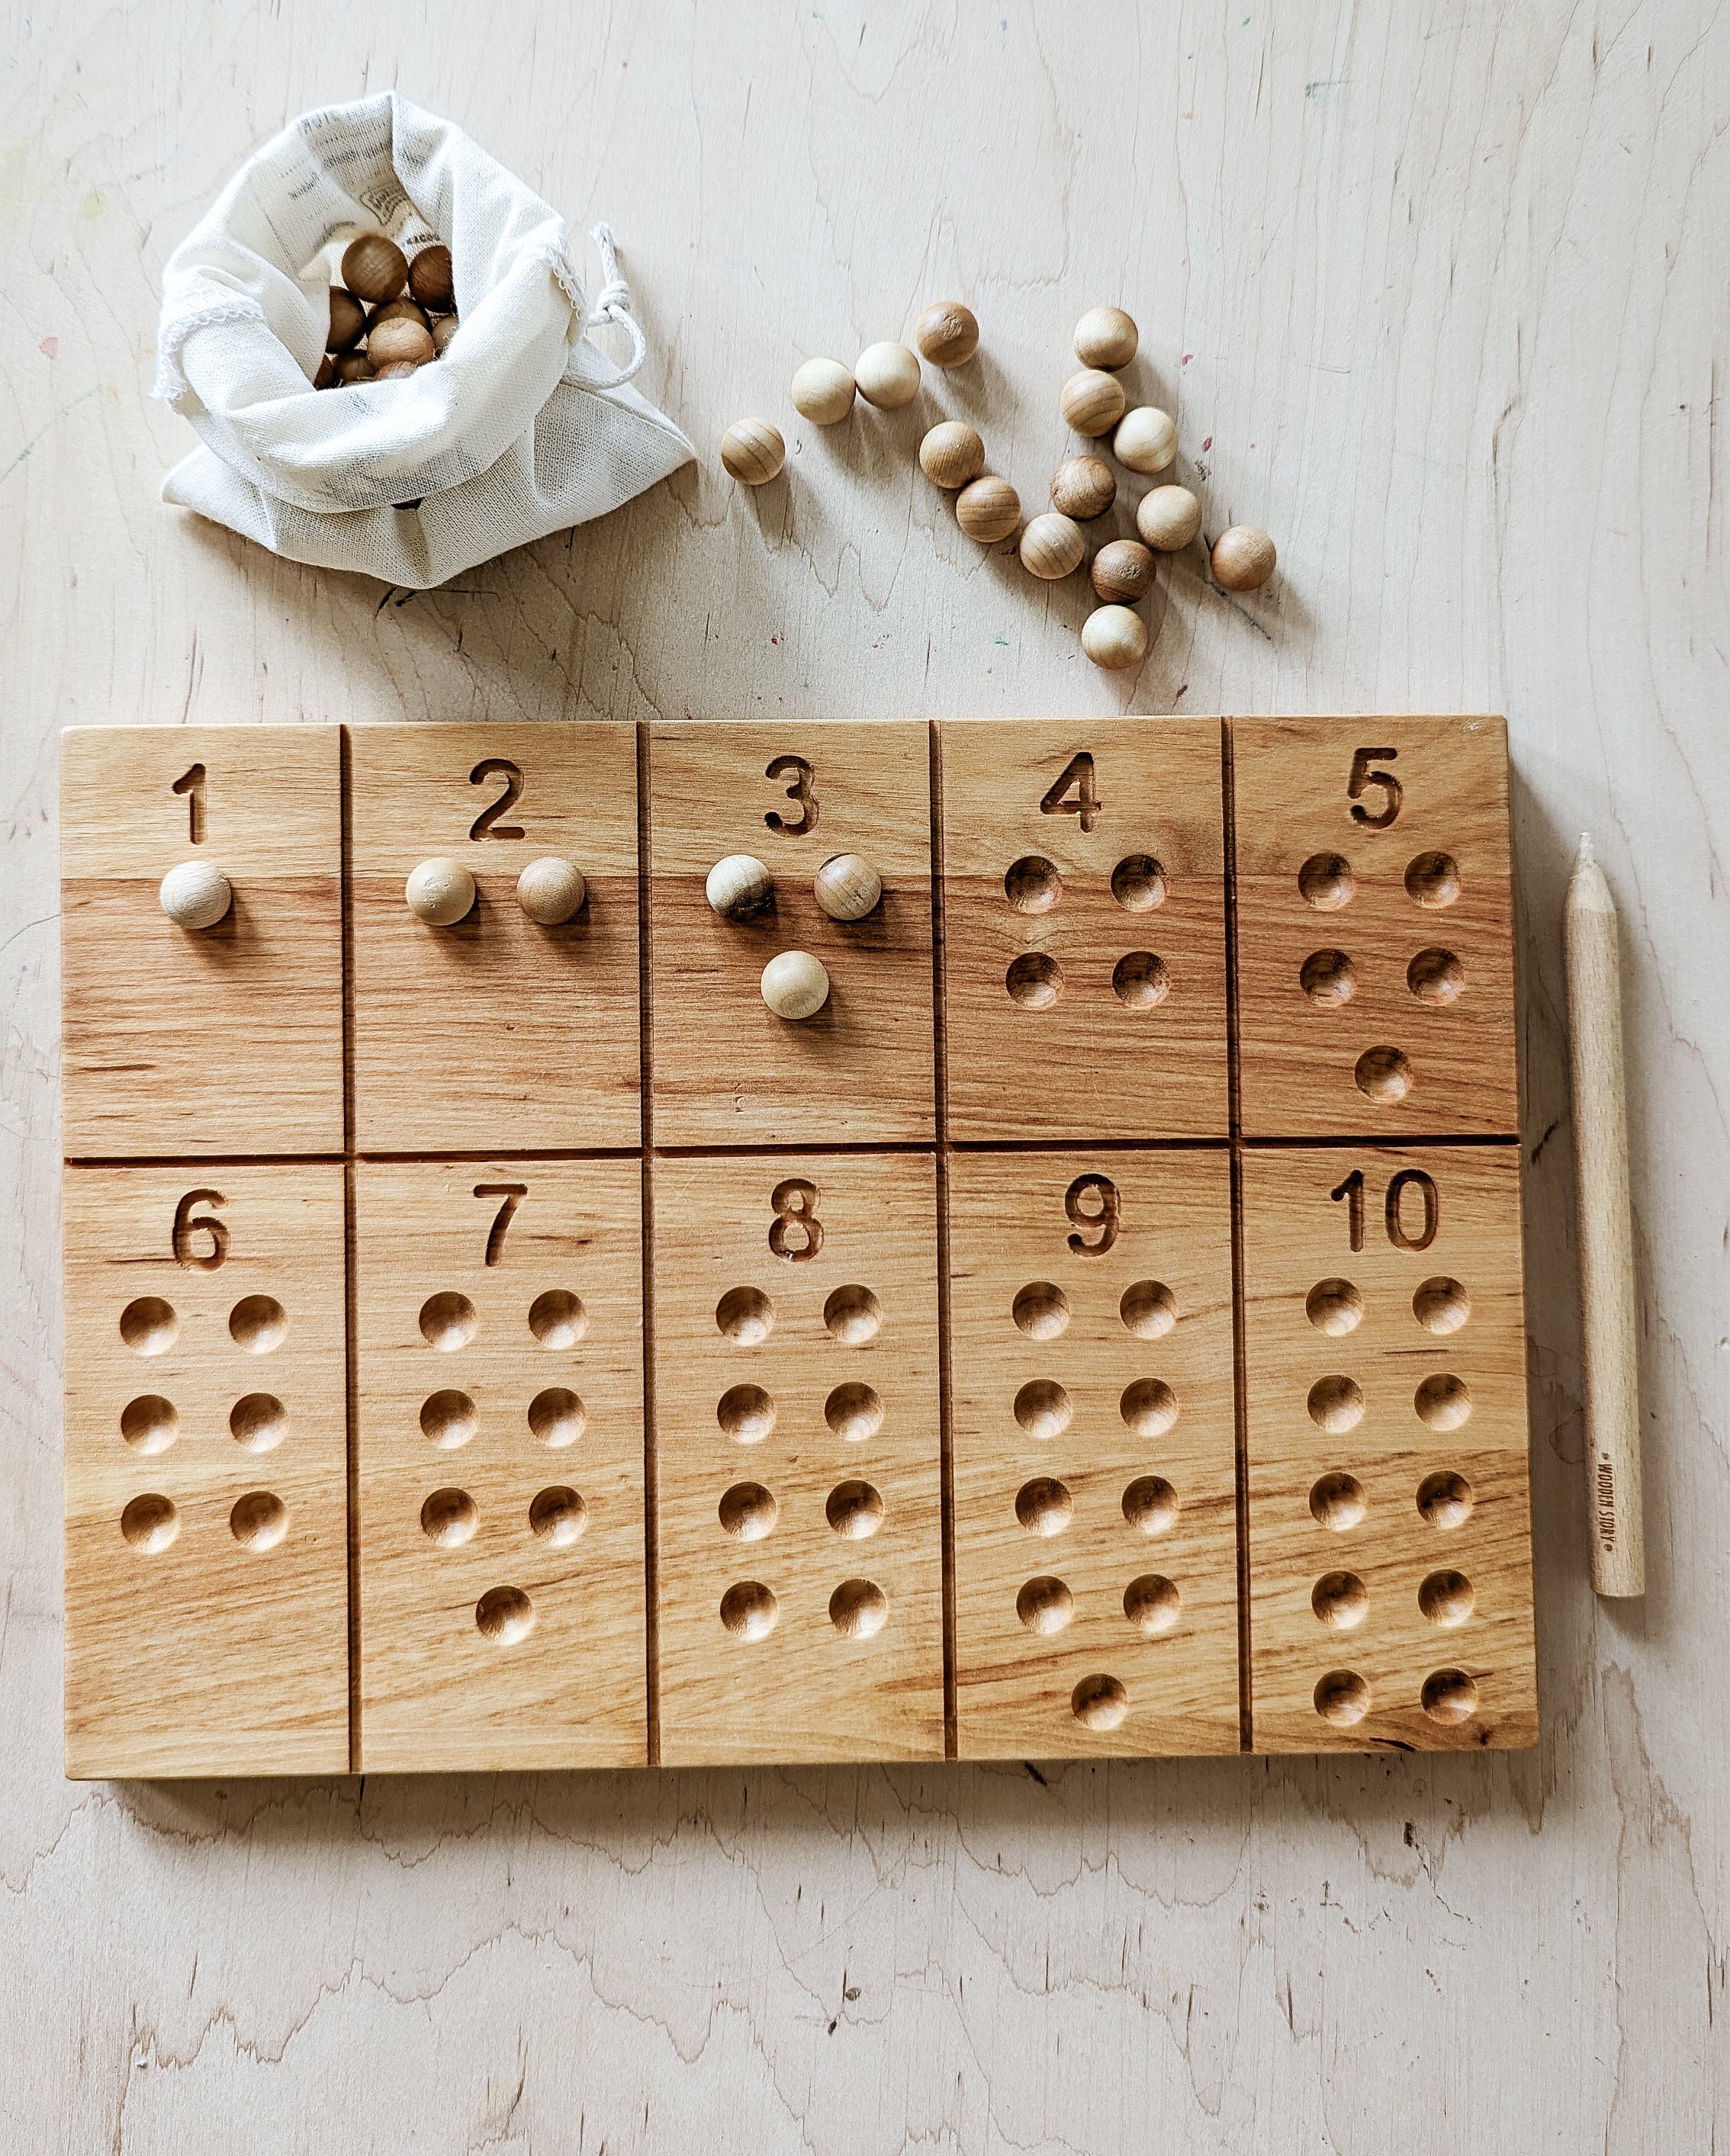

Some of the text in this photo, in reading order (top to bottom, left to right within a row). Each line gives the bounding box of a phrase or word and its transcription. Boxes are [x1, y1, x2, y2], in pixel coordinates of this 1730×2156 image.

[172, 763, 207, 845] 1
[468, 758, 526, 841] 2
[764, 755, 819, 837] 3
[1040, 751, 1102, 833] 4
[1347, 747, 1404, 829] 5
[172, 1188, 230, 1272] 6
[474, 1183, 528, 1267] 7
[769, 1178, 825, 1262] 8
[1064, 1173, 1121, 1256] 9
[1330, 1168, 1439, 1252] 10
[1597, 1464, 1616, 1543] WOODEN STORY
